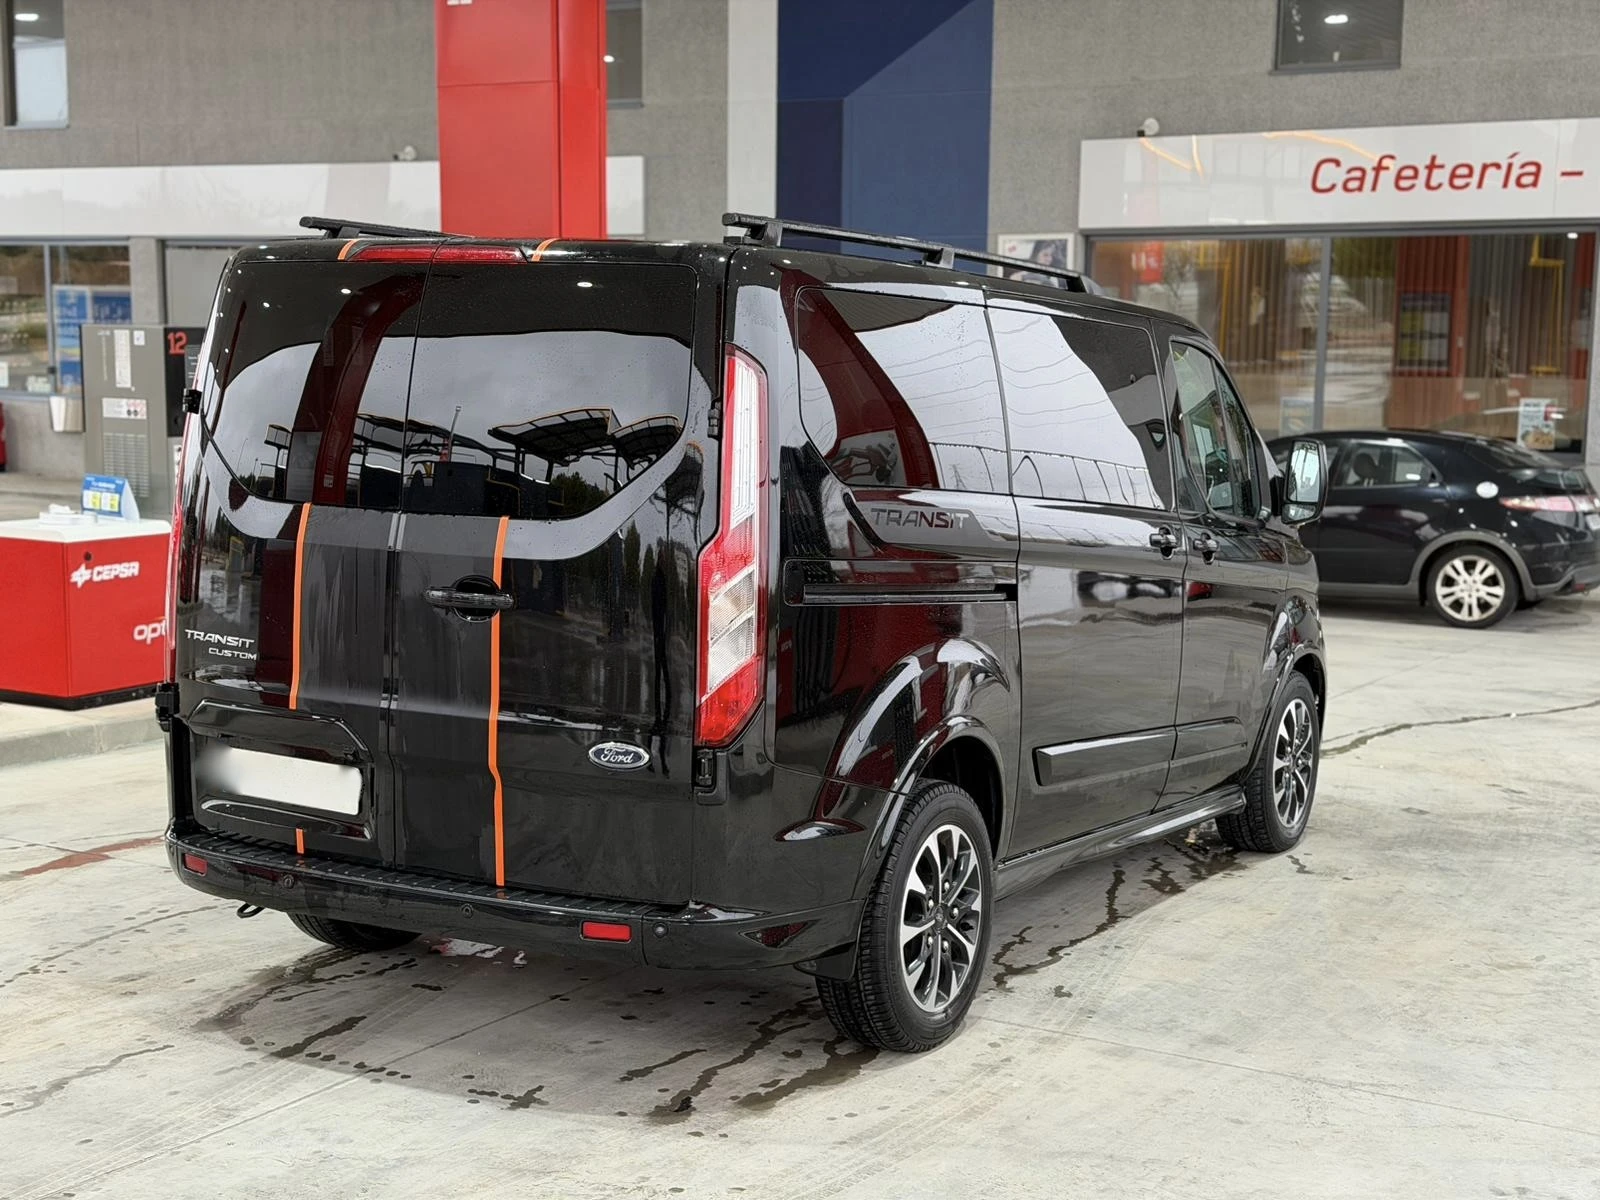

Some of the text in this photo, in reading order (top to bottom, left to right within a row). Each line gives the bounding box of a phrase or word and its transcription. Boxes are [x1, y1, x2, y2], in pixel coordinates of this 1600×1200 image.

[1310, 152, 1542, 194] Cafetería
[167, 331, 188, 354] 12
[870, 507, 969, 529] TRANSIT
[92, 561, 140, 582] CEPSA
[184, 629, 255, 648] TRANSIT
[208, 647, 257, 660] CUSTOM
[600, 747, 634, 763] Ford
